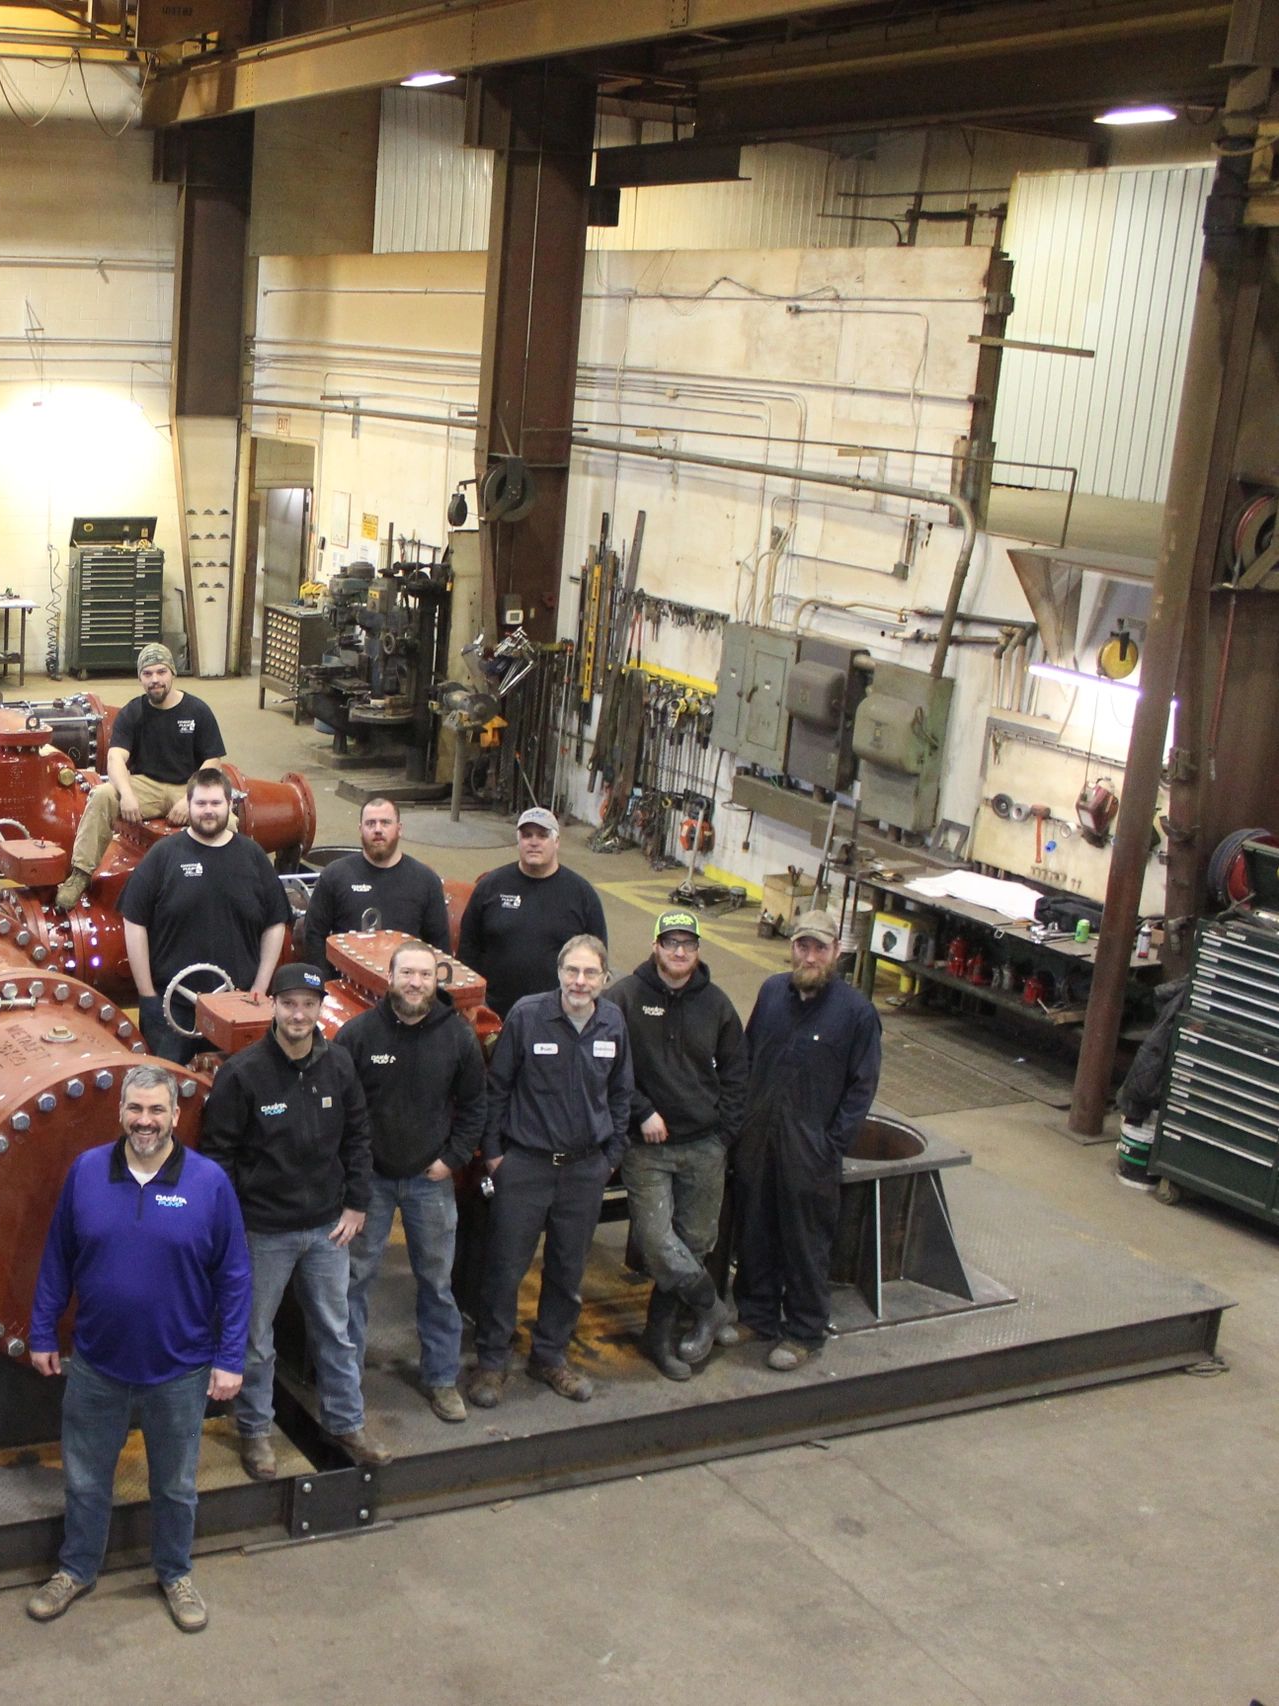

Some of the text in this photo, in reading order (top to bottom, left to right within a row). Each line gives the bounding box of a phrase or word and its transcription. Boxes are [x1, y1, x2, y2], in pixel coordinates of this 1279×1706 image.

[663, 913, 694, 924] DAKOTA
[261, 1102, 288, 1112] DAKOTA
[156, 1194, 187, 1205] DAKOTA
